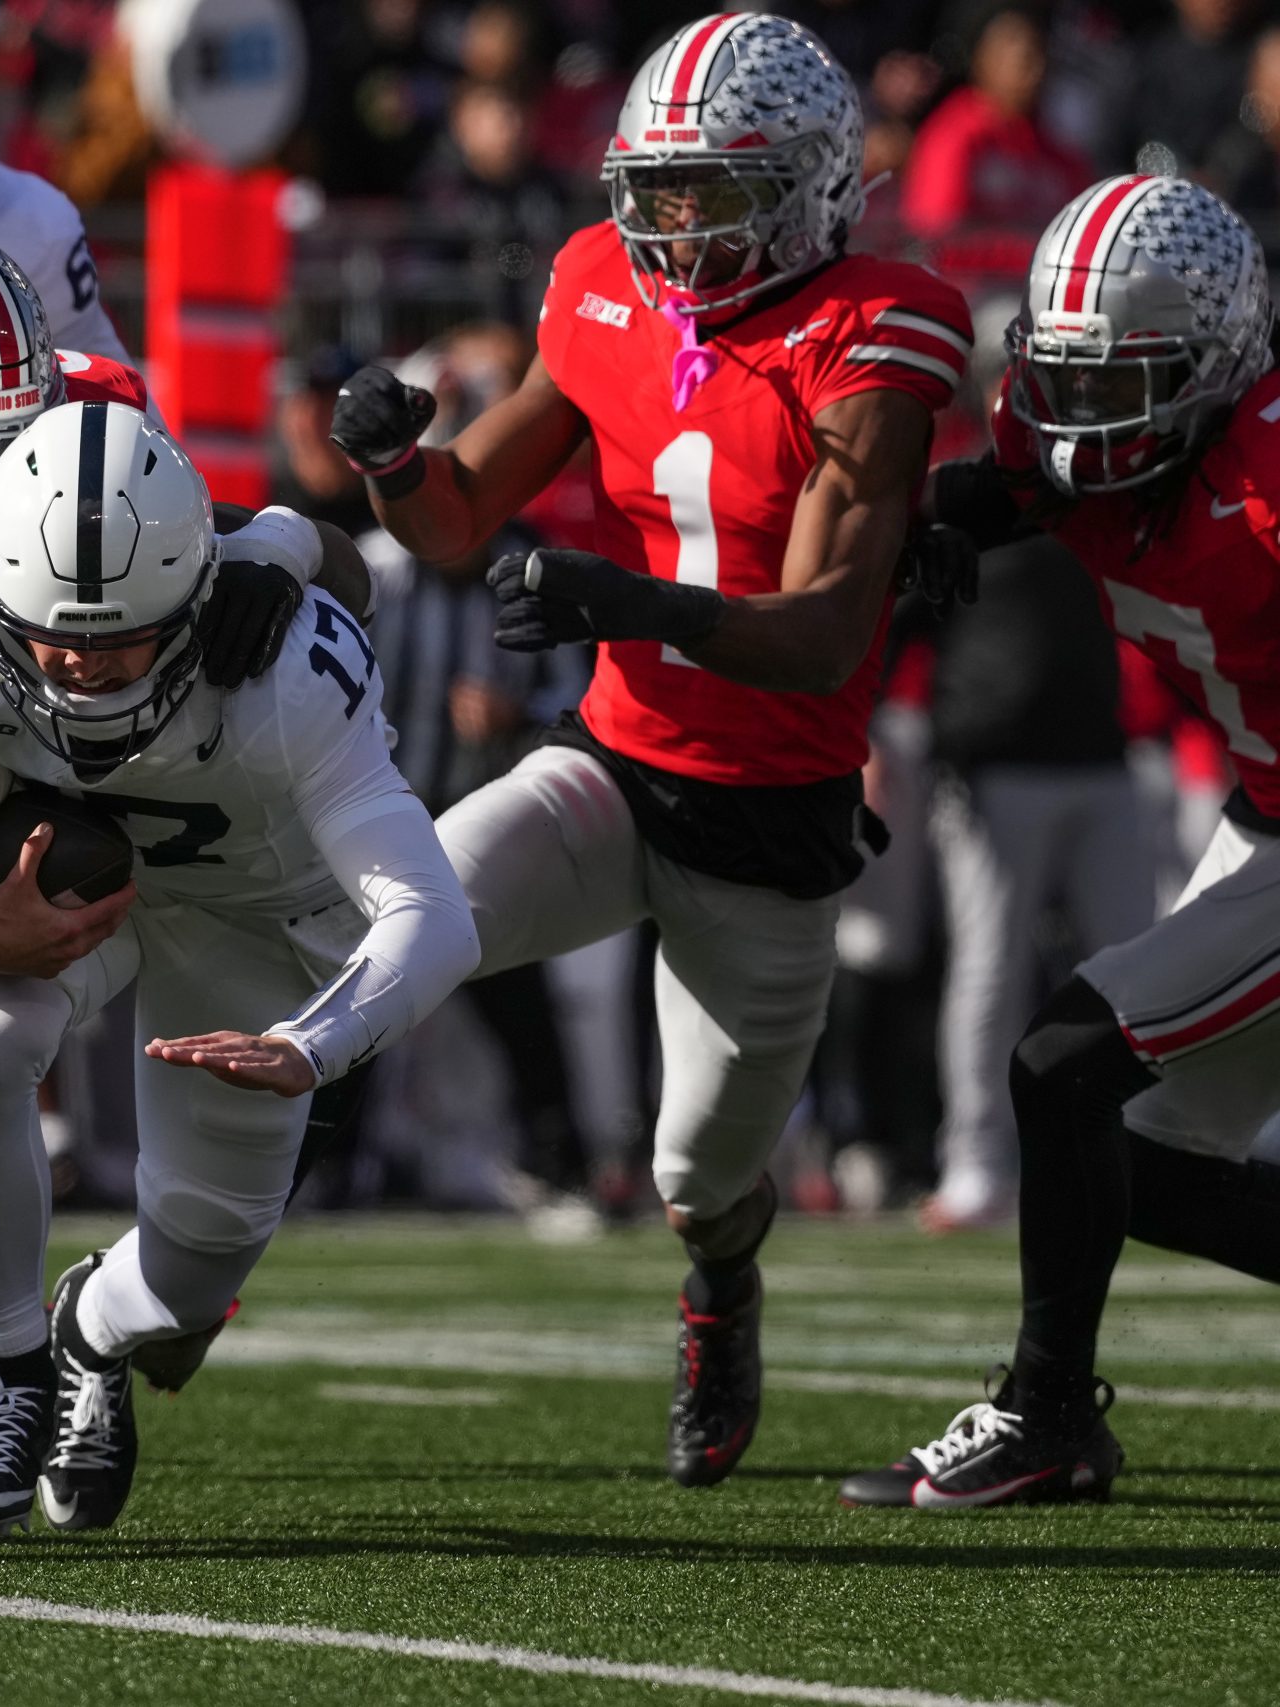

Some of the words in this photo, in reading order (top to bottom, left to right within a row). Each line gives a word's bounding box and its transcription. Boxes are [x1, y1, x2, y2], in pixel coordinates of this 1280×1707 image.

[15, 388, 40, 409] STATE
[652, 430, 719, 670] 1
[58, 612, 87, 621] PENN
[89, 610, 122, 621] STATE
[308, 598, 376, 722] 17
[1102, 576, 1278, 766] 7
